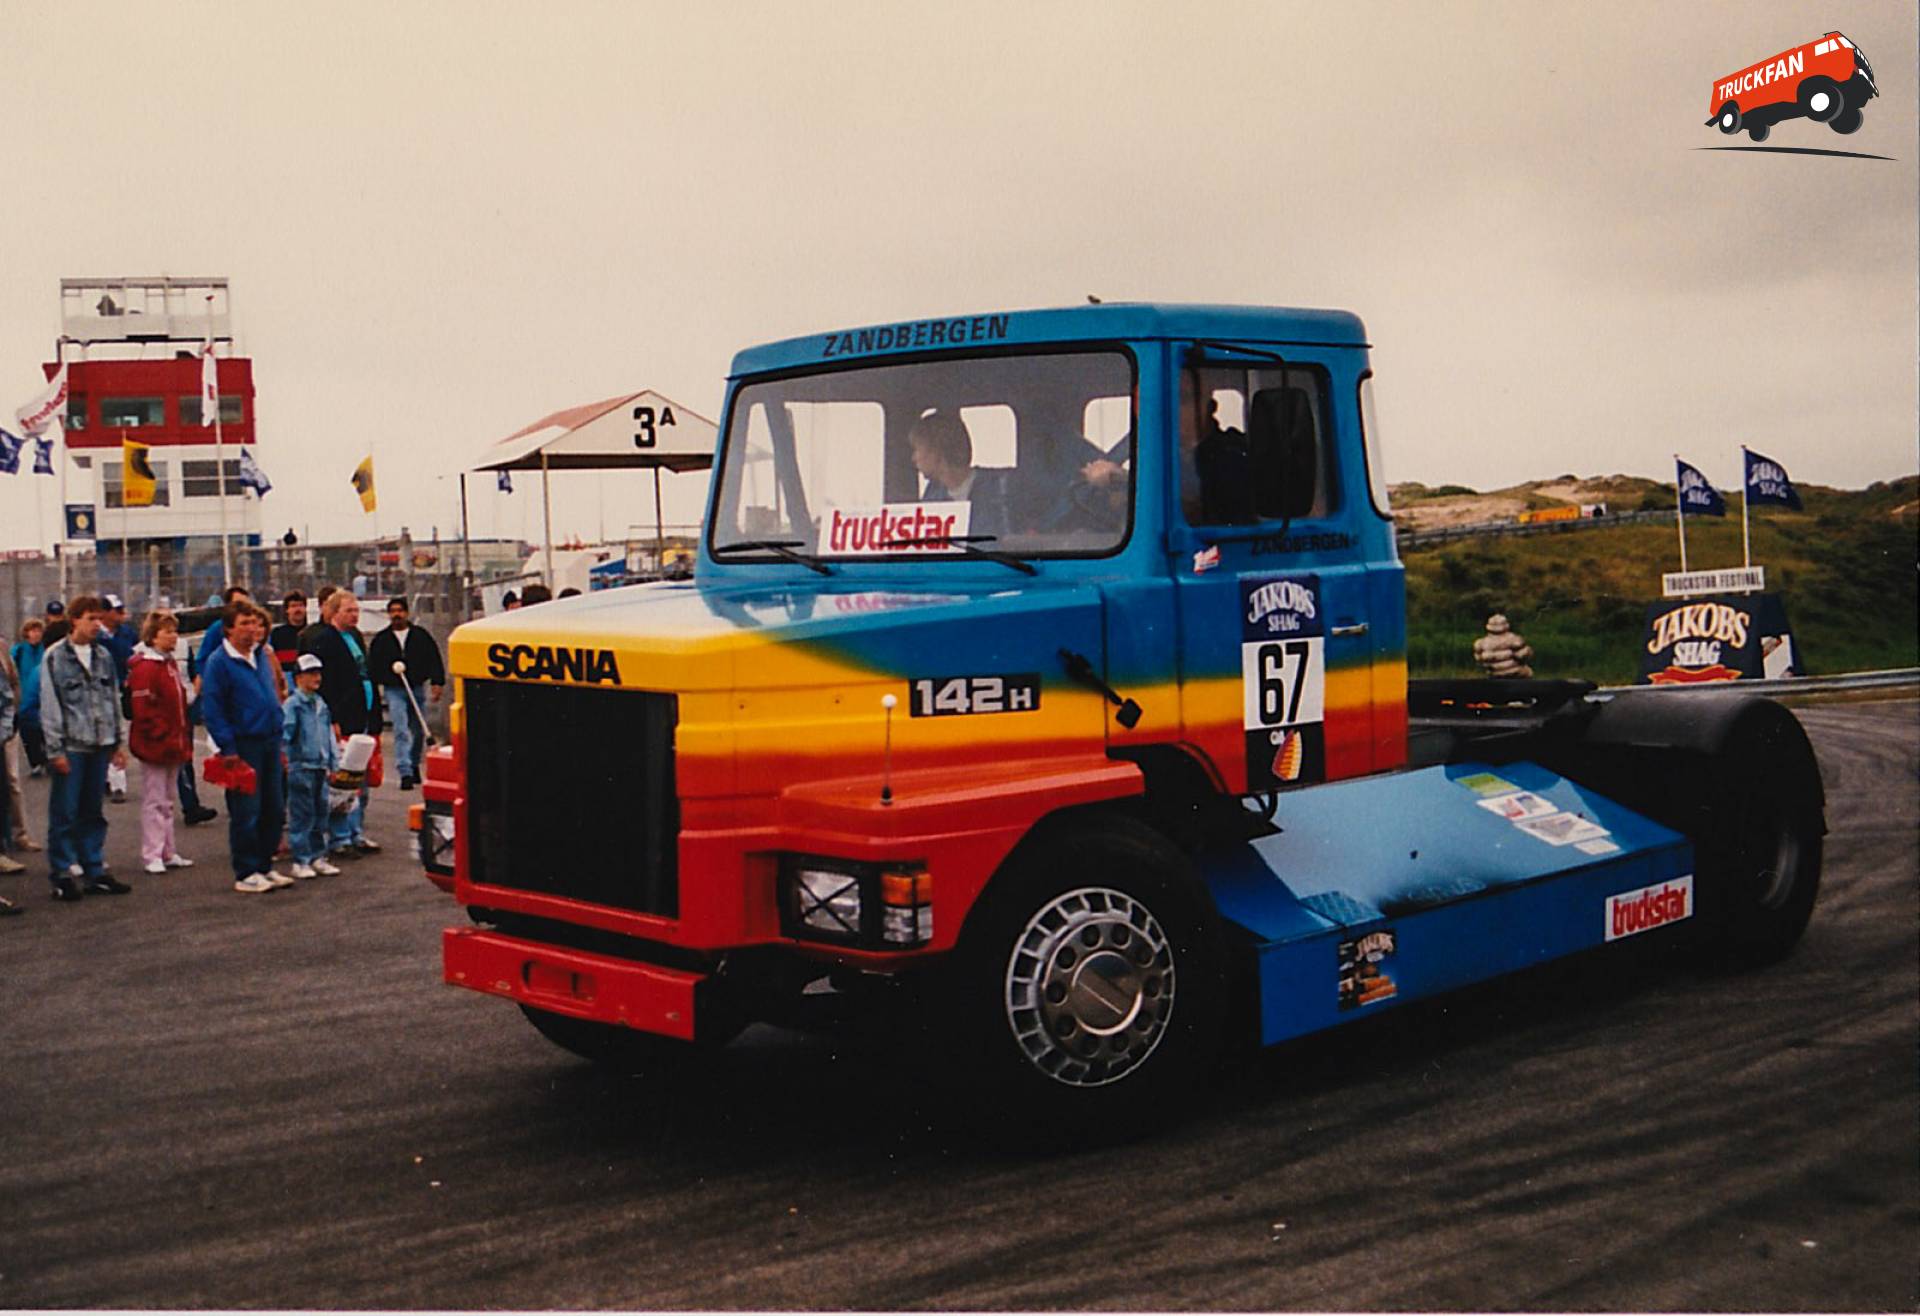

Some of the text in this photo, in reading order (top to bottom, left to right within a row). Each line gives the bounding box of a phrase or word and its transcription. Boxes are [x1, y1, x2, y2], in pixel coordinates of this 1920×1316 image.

[823, 315, 1009, 357] ZANDBERGEN
[830, 506, 956, 551] truckstar
[1666, 570, 1761, 591] TRUCKSTAR FESTIVAL
[1248, 581, 1315, 624] JAKOBS
[1268, 613, 1300, 632] SHAG
[1648, 602, 1750, 655] JAKOBS
[487, 642, 622, 685] SCANIA
[1672, 641, 1721, 666] SHAG
[1258, 641, 1309, 725] 67
[1613, 884, 1686, 936] truckstar
